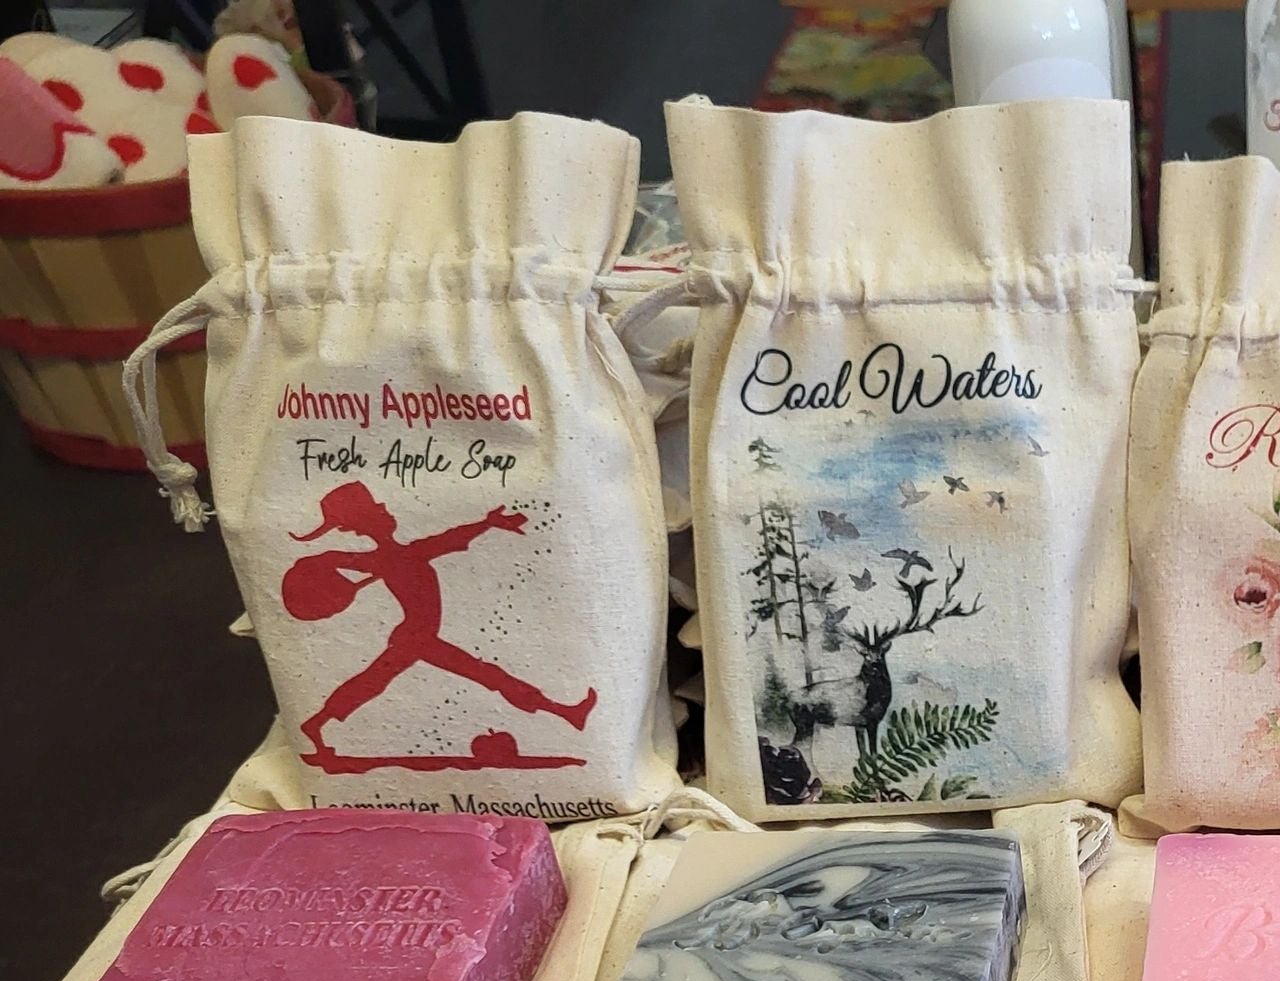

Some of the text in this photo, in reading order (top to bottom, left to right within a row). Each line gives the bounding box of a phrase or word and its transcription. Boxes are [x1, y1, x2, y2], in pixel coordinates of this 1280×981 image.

[741, 342, 1043, 416] Cool Waters
[277, 382, 532, 429] Johnny Appleseed
[297, 435, 517, 488] Fresh Apple Soap
[449, 793, 619, 819] Massachusetts
